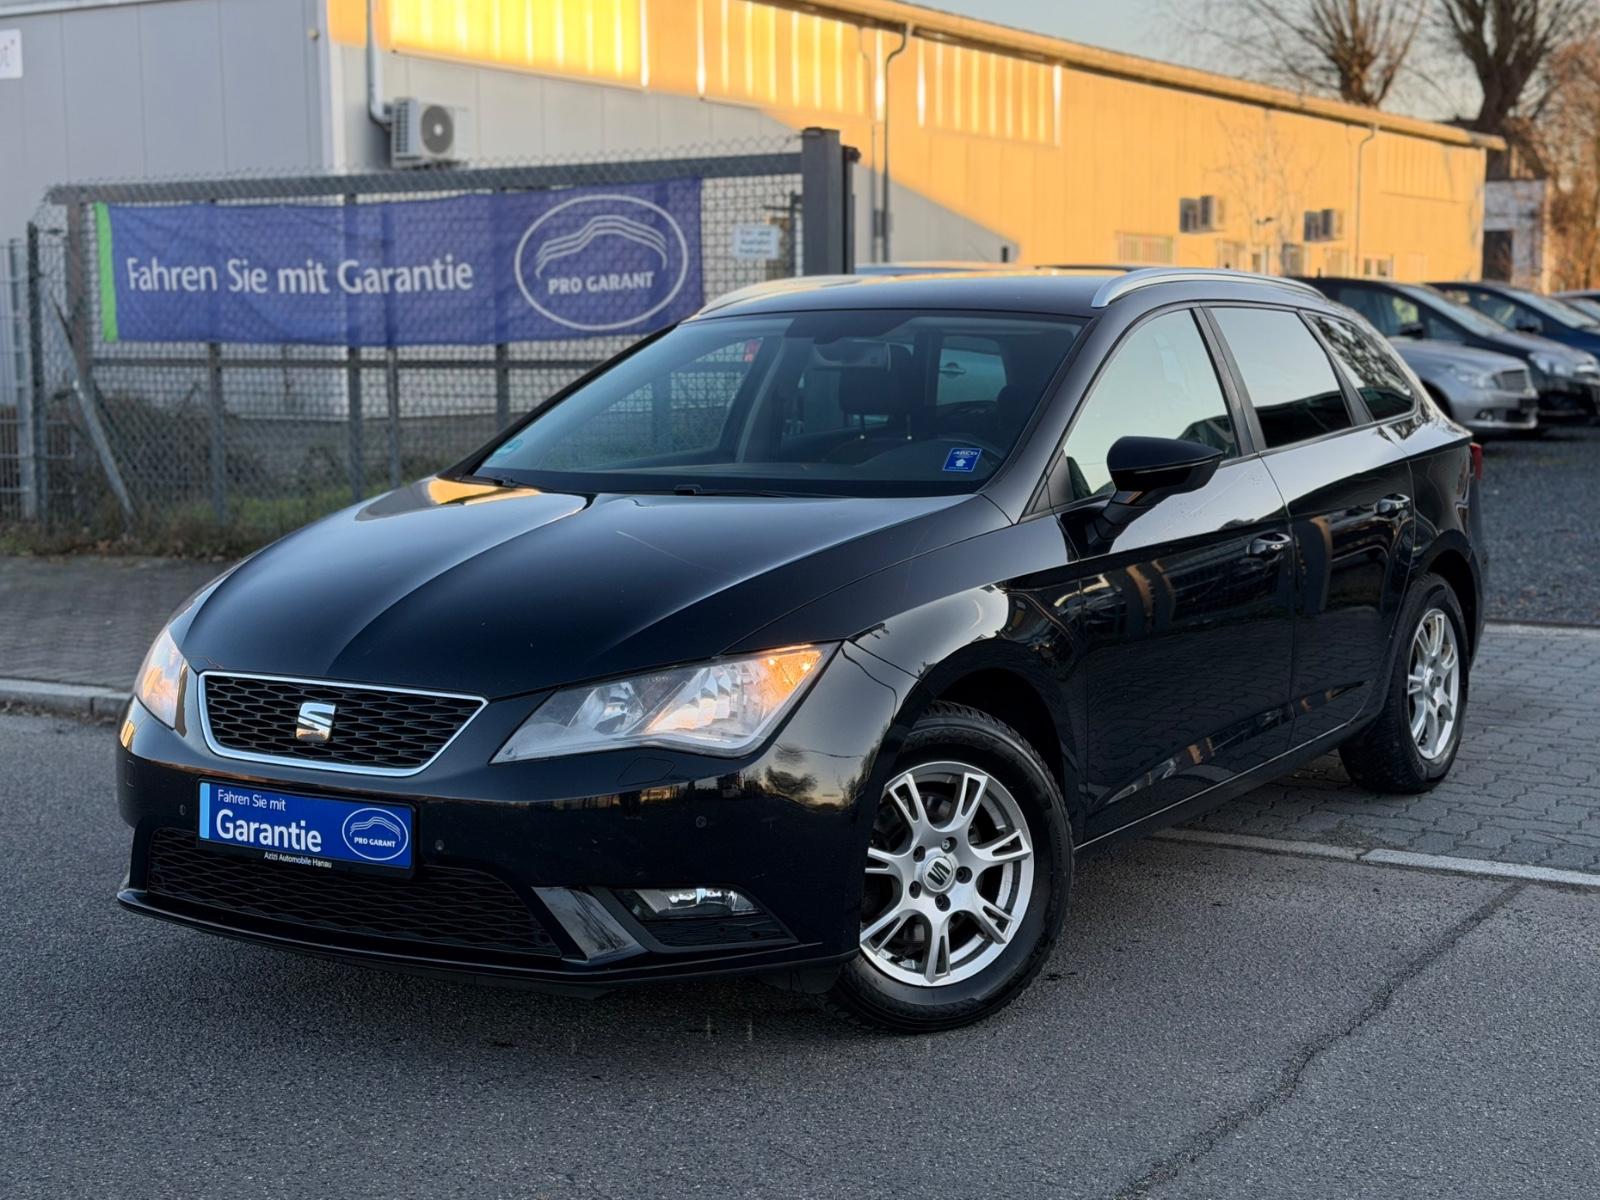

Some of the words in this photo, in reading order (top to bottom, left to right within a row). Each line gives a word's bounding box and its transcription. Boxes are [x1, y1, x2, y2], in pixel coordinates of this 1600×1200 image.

[127, 257, 218, 292] Fahren
[228, 258, 268, 294] Sie
[278, 257, 330, 294] mit
[337, 254, 474, 294] Garantie
[548, 279, 582, 295] PRO
[587, 272, 655, 293] GARANT
[217, 789, 250, 806] Fahren
[252, 794, 267, 808] Sie
[270, 798, 286, 811] mit
[216, 808, 322, 852] Garantie
[354, 837, 368, 845] PRO
[369, 838, 396, 848] GARANT
[279, 853, 311, 866] Automobile
[312, 858, 332, 869] Hanau
